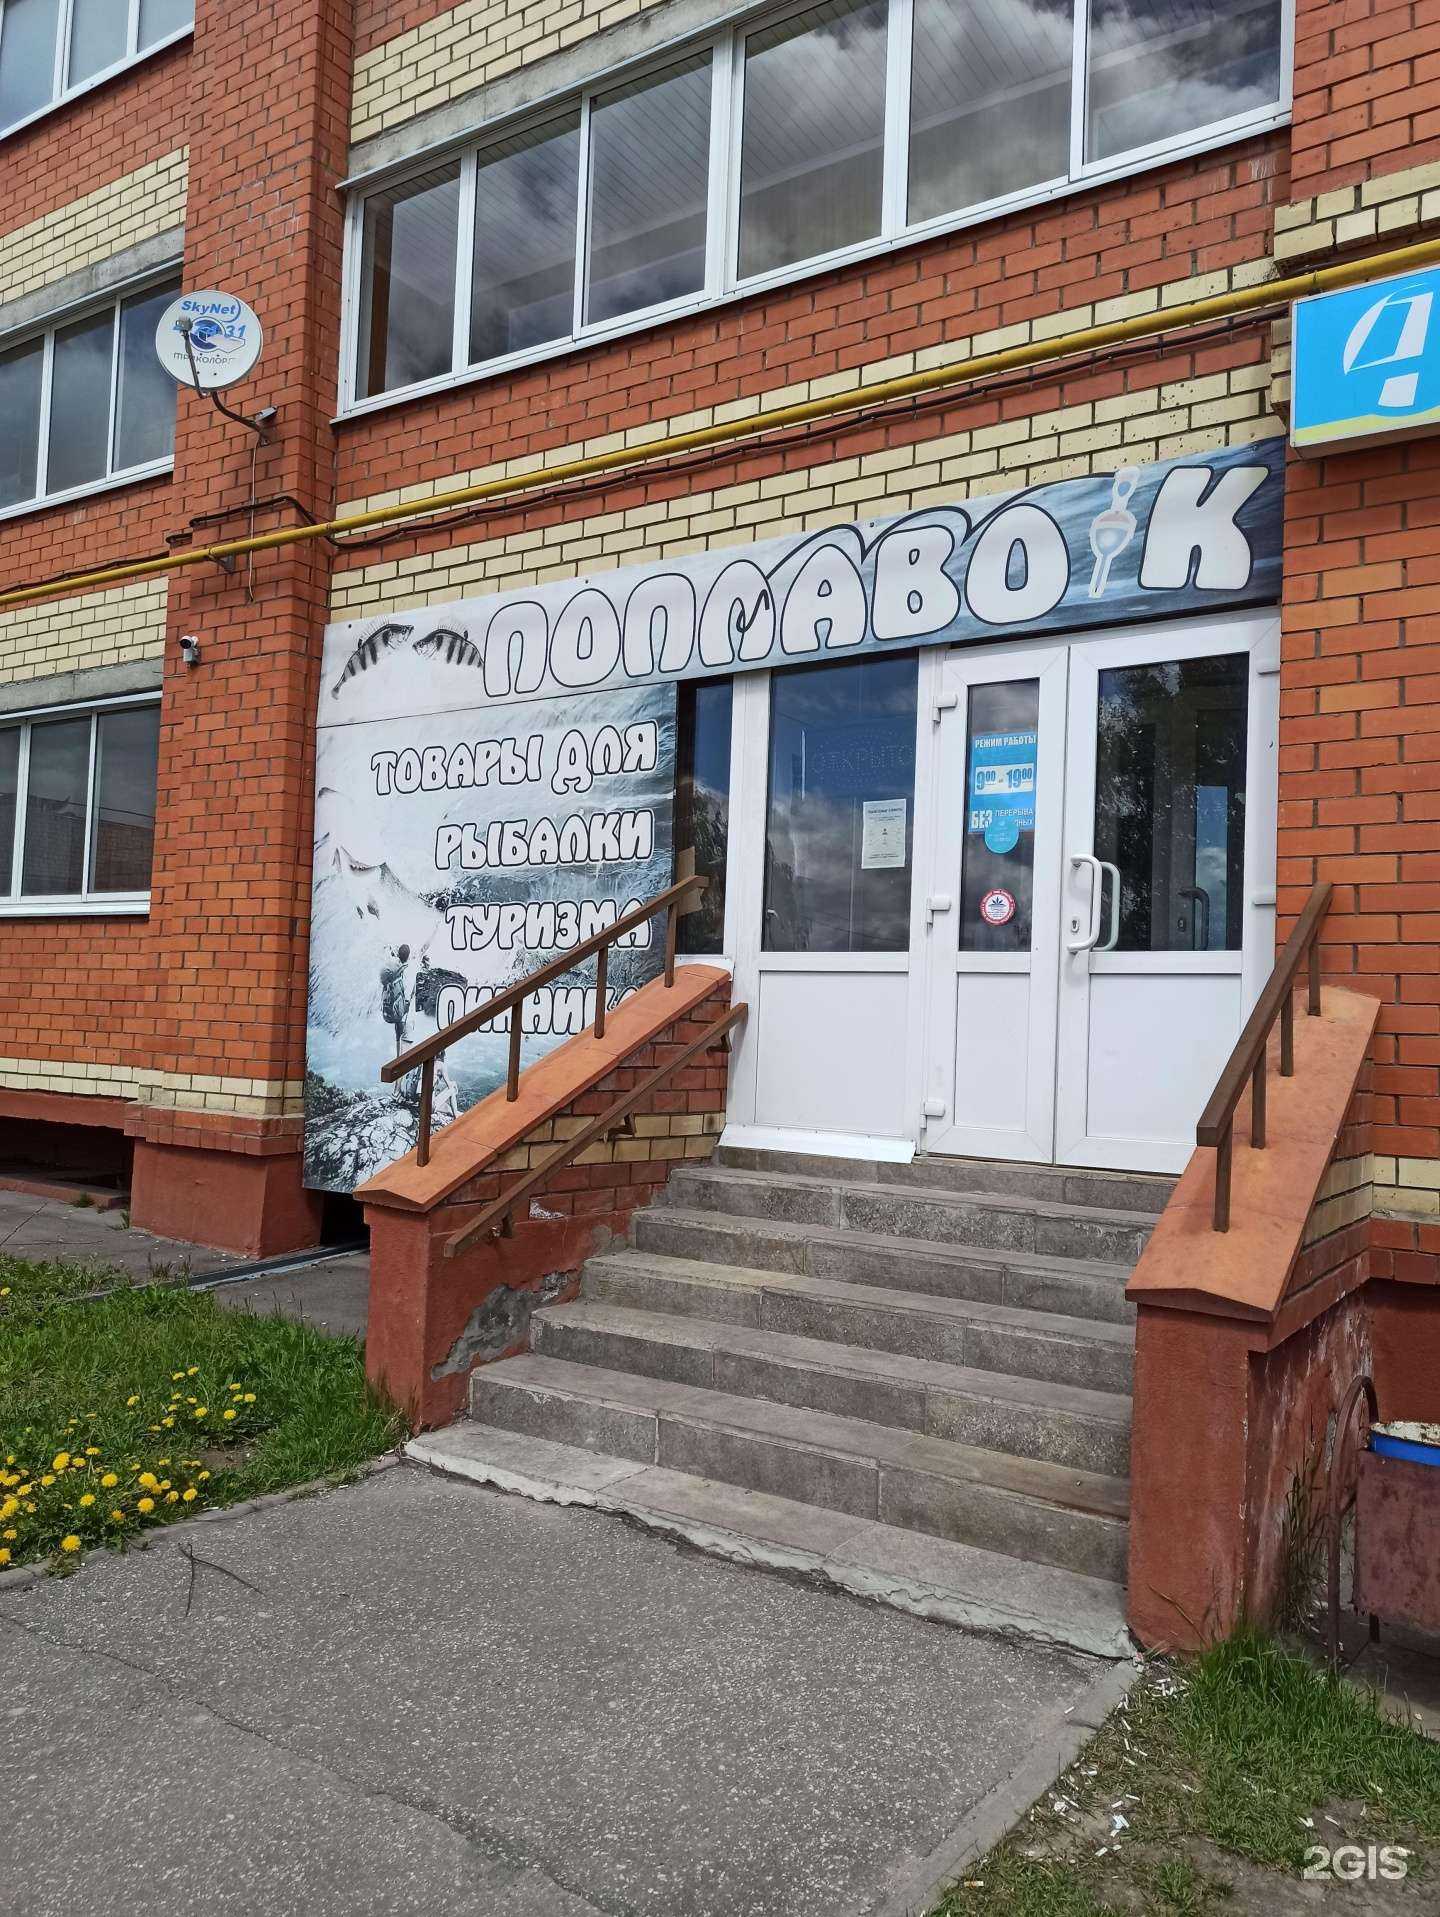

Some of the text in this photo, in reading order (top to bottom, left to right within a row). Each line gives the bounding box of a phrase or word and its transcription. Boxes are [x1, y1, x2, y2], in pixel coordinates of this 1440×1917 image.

[181, 300, 236, 315] SkyNet
[370, 720, 659, 796] ТОВАРЫ ДЛЯ
[975, 734, 1037, 749] РЕЖИМ РАБОТЫ
[971, 809, 993, 829] БЕЗ
[434, 809, 655, 870] РЫБАЛКИ
[445, 898, 652, 950] ТУРИЗМА
